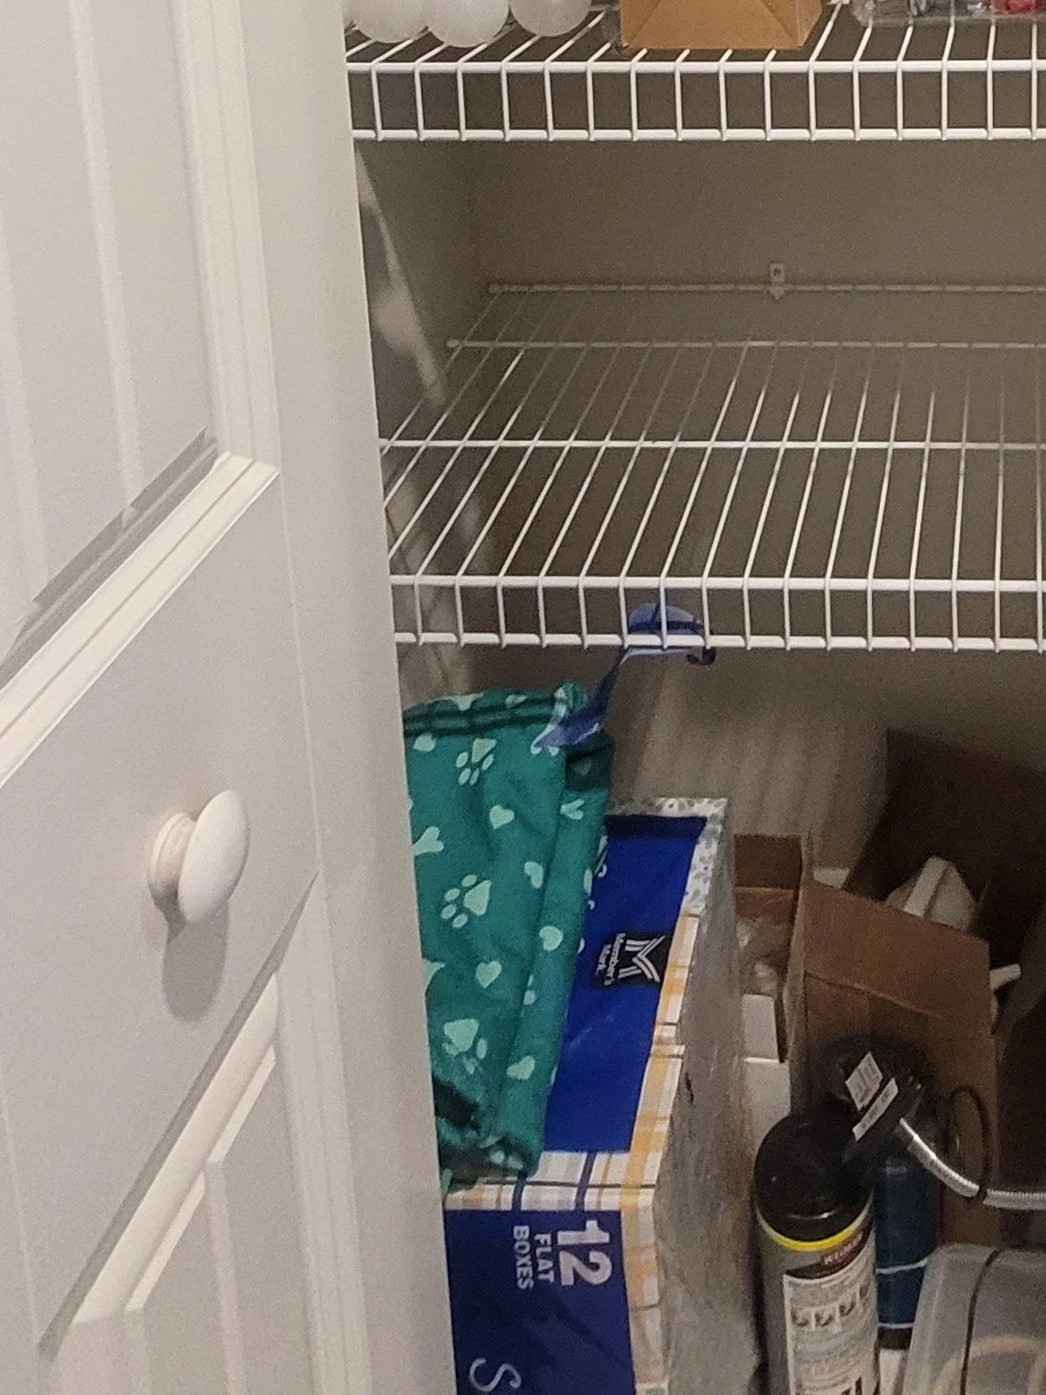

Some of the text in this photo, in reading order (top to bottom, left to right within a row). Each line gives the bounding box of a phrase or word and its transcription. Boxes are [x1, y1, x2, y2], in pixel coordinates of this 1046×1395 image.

[512, 1224, 535, 1291] BOXES
[534, 1232, 555, 1284] FLAT
[556, 1219, 613, 1287] 12
